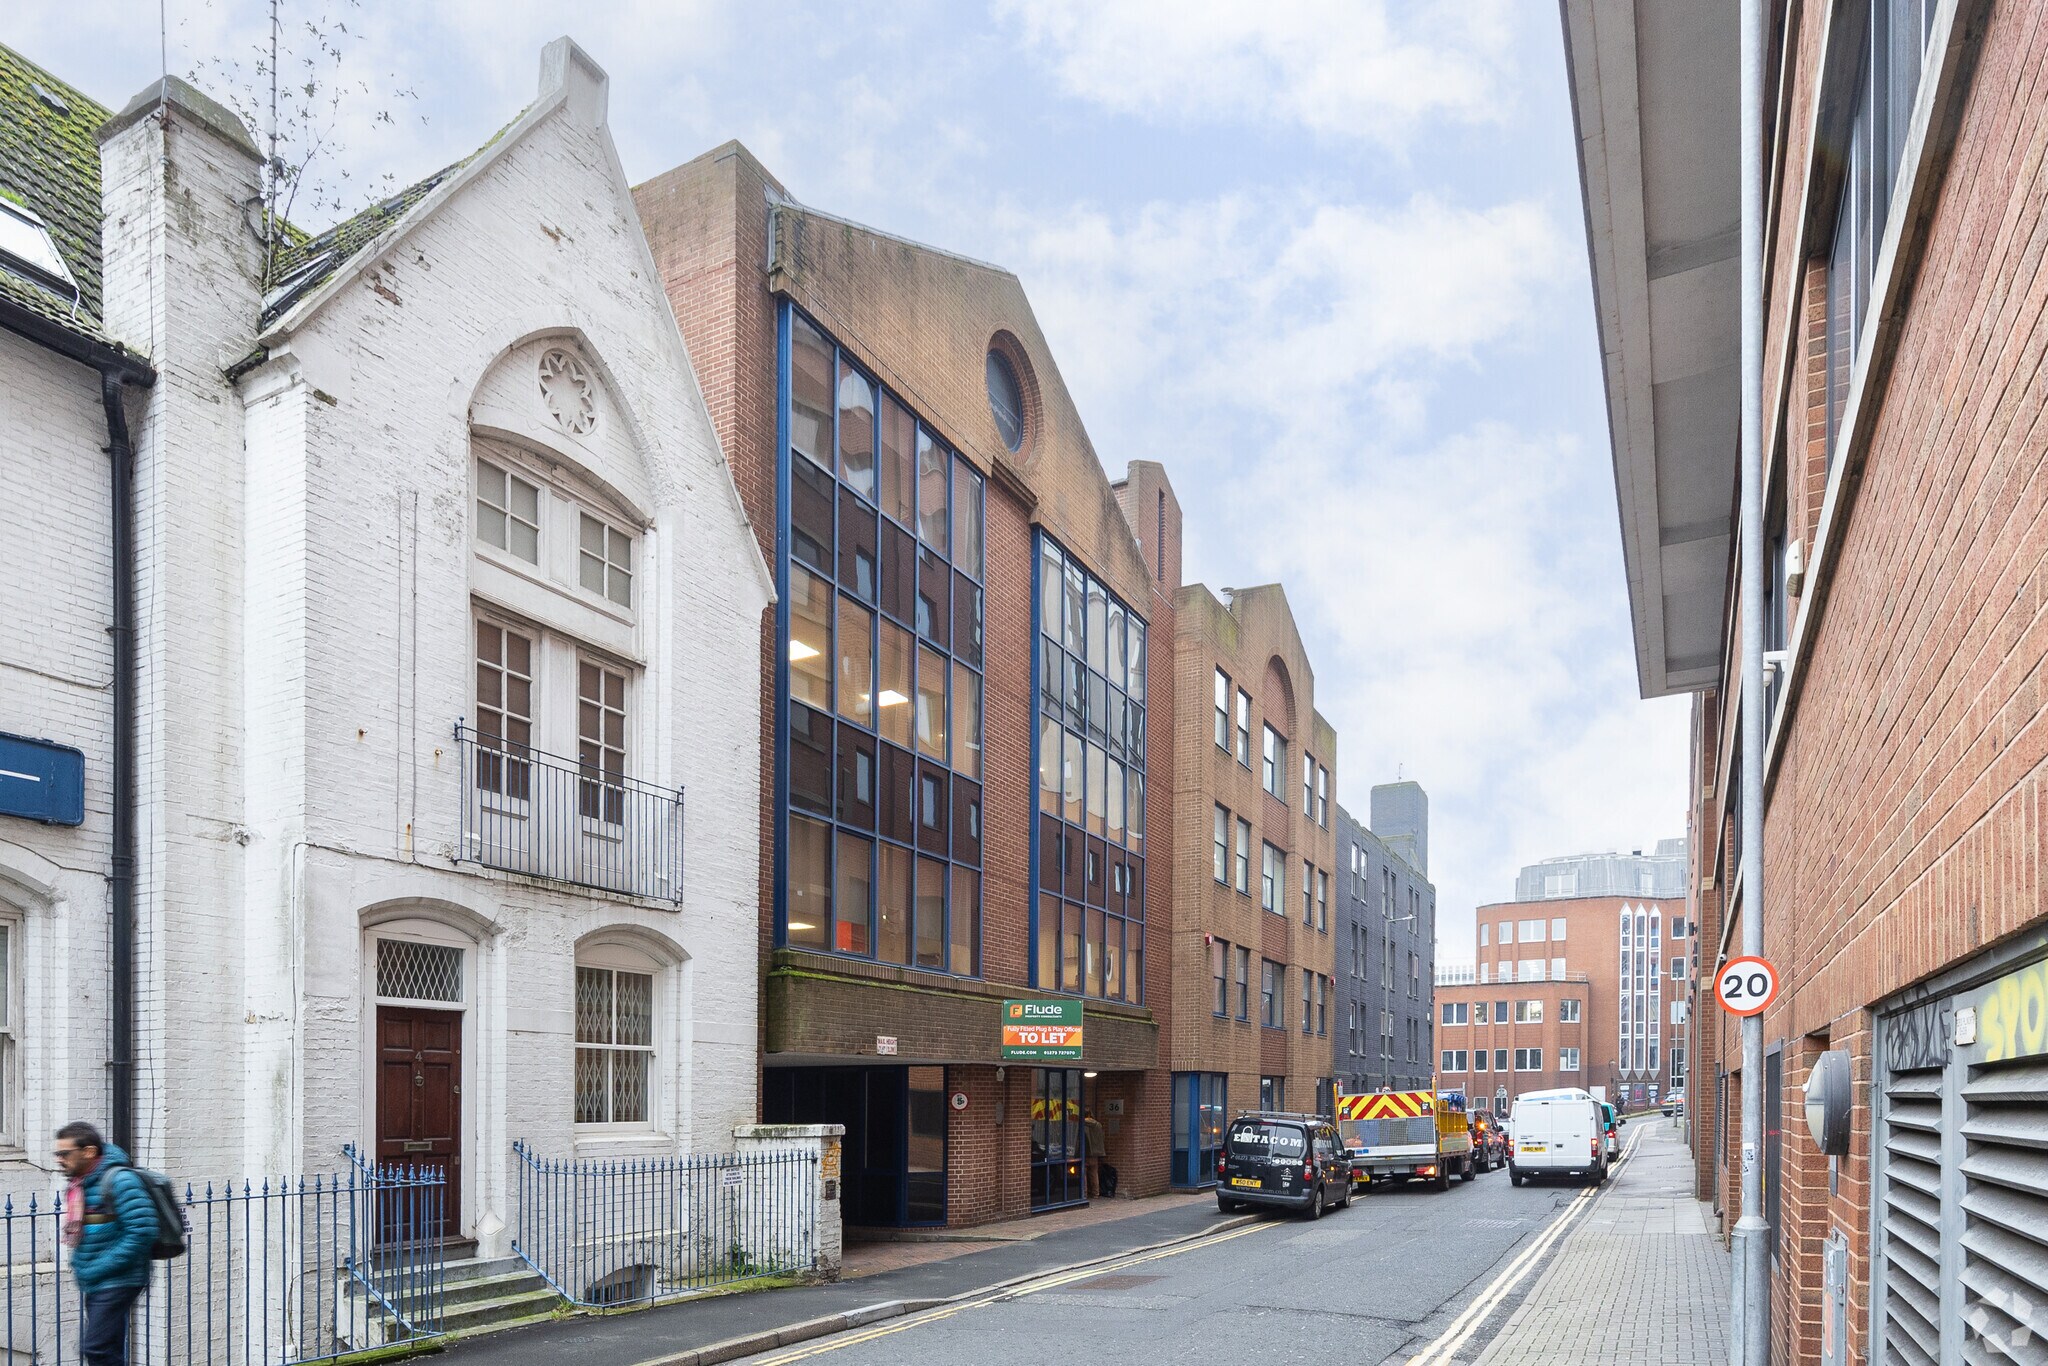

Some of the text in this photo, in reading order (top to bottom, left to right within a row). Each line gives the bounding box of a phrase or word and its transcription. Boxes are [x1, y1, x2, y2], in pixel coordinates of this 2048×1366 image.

[1724, 973, 1768, 999] 20
[1025, 1004, 1062, 1014] Flude
[1019, 1032, 1066, 1044] TO LET
[415, 1052, 422, 1061] 4
